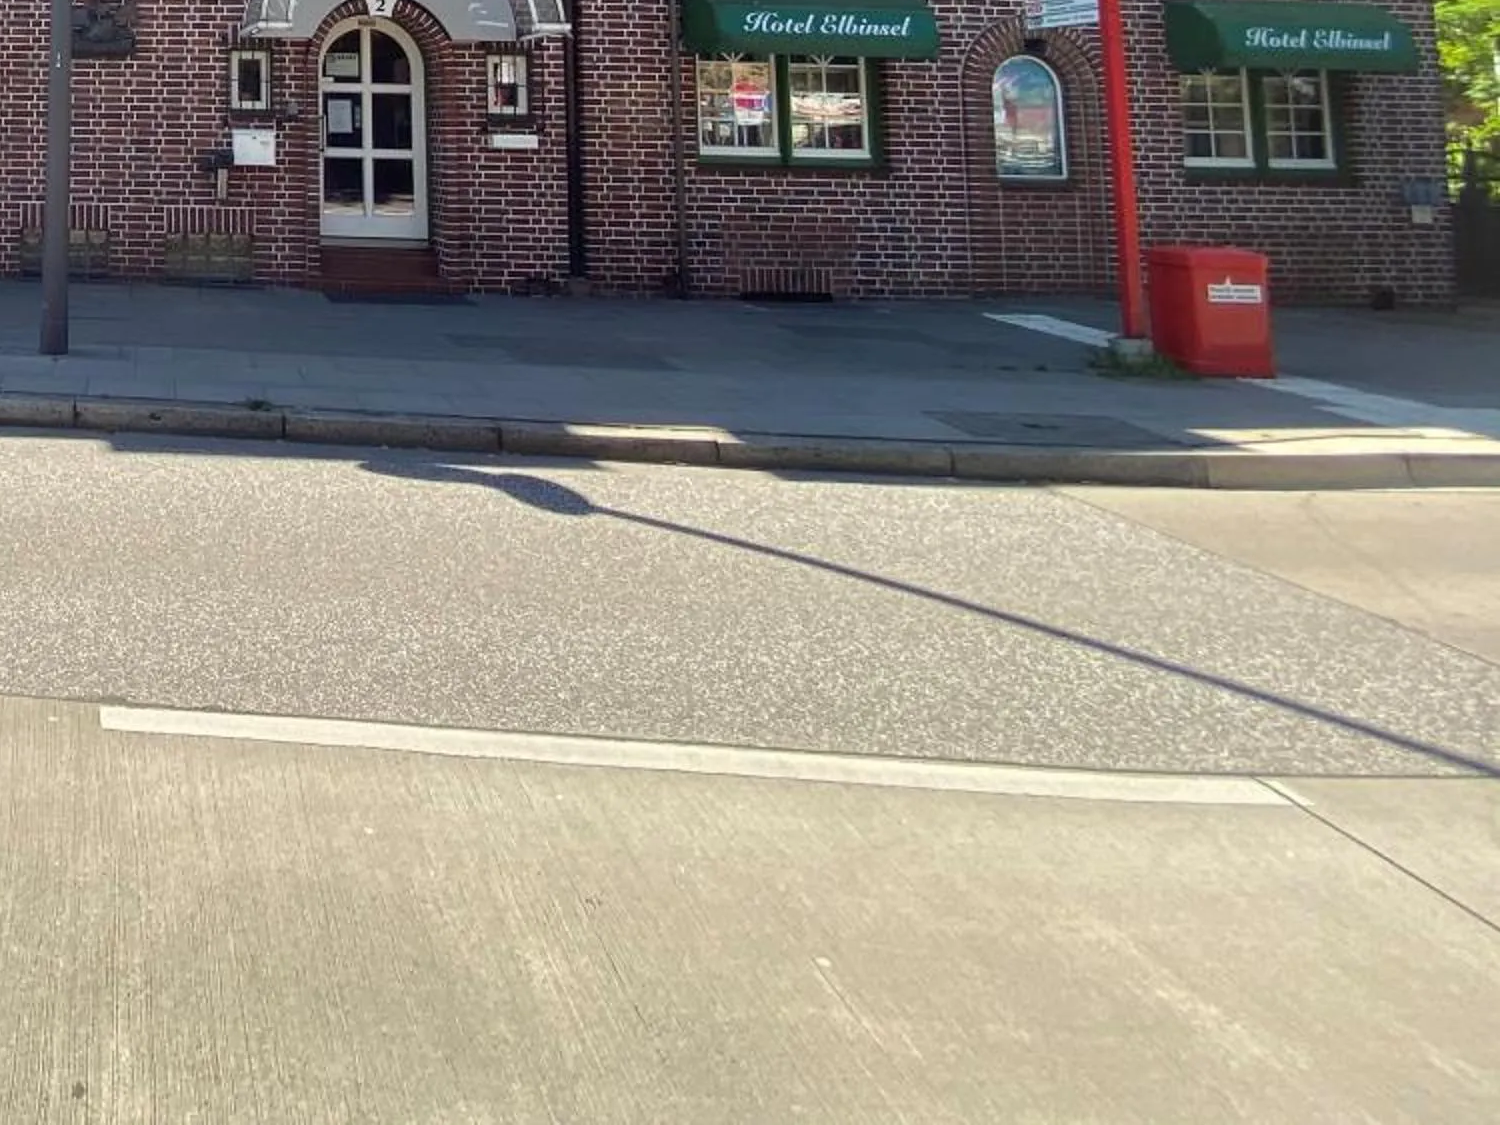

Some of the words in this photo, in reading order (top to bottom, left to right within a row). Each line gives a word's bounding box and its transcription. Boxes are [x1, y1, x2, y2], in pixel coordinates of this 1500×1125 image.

[743, 11, 815, 35] Hotel
[820, 14, 911, 37] Elbinsel
[1245, 27, 1307, 49] Hotel
[1313, 29, 1391, 51] Elbinsel
